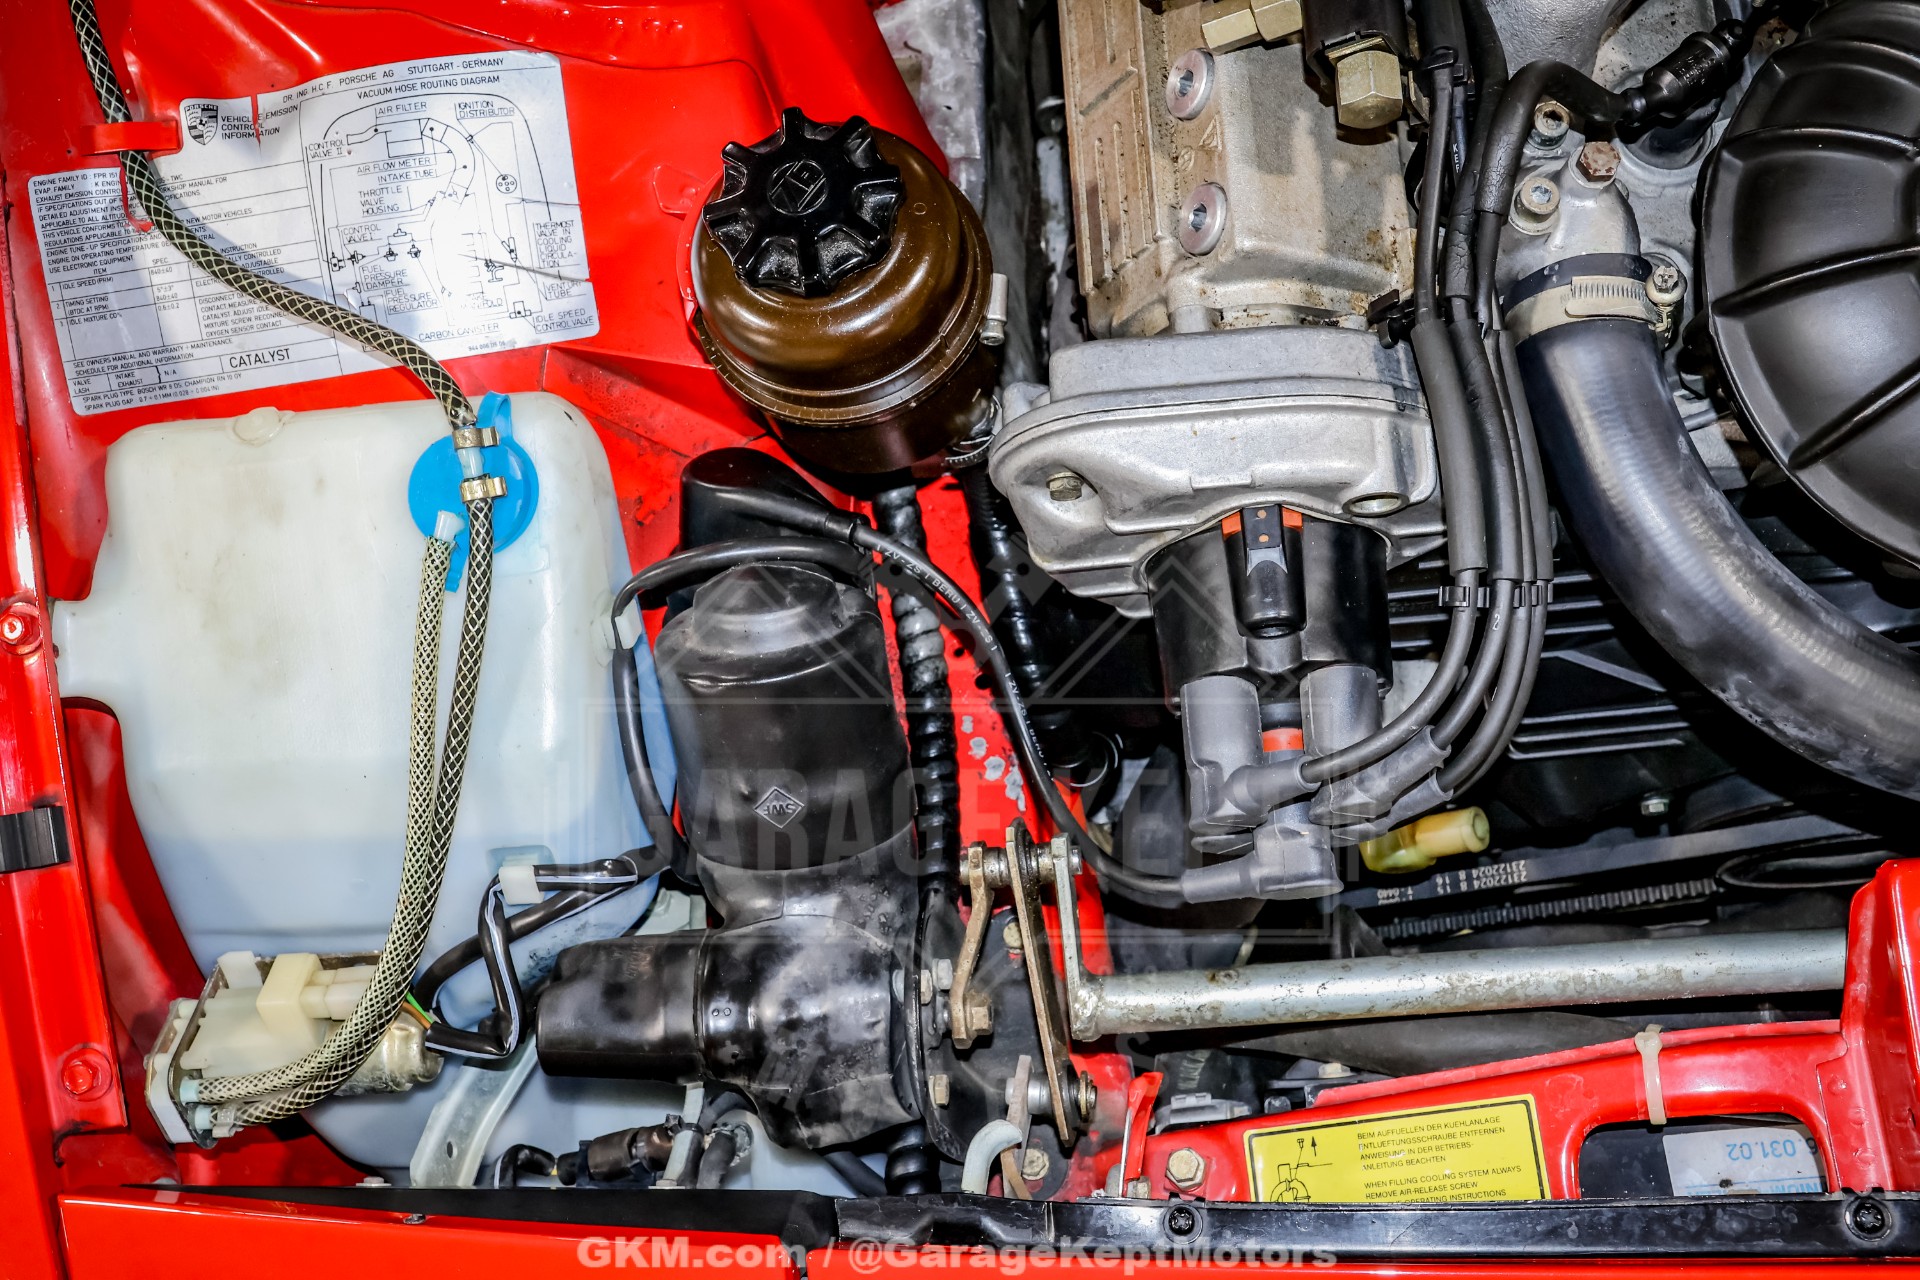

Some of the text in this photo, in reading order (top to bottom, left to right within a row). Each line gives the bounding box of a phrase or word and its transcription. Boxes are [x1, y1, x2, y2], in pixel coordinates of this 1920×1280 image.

[340, 73, 377, 86] PORSCHE
[408, 62, 454, 75] STUTTGART
[462, 58, 504, 69] GERMANY
[357, 76, 500, 100] VACUUM HOSE ROUTING DIAGRAM
[378, 102, 427, 115] AIR FILTER
[458, 100, 494, 110] IGNITION
[266, 104, 298, 120] EMISSION
[459, 107, 515, 118] DISTRIBUTOR
[308, 139, 345, 151] CONTROL
[310, 150, 332, 159] VALVE
[374, 162, 396, 171] FLOW
[398, 157, 431, 168] METER
[378, 169, 434, 182] INTAKE TUBE
[33, 179, 56, 187] ENGINE
[54, 184, 74, 192] FAMILY
[189, 178, 214, 188] MANUAL
[36, 191, 93, 203] EXHAUST EMISSION
[358, 185, 402, 198] THROTTLE
[45, 201, 92, 212] SPECIFICATIONS
[360, 197, 384, 207] VALVE
[39, 207, 108, 221] DETAILED ADJUSTMENT
[203, 213, 222, 222] MOTOR
[224, 208, 252, 218] VEHICLES
[362, 204, 400, 216] HOUSING
[41, 219, 76, 229] APPLICABLE
[57, 228, 80, 237] VEHICLE
[82, 223, 115, 233] CONFORMS
[343, 224, 381, 235] CONTROL
[536, 220, 574, 229] THERMOST
[44, 231, 121, 247] REGULATIONS APPLICABLE
[346, 234, 368, 243] VALVE
[537, 229, 558, 237] VALVE
[46, 248, 68, 257] ENGINE
[100, 236, 148, 249] SPECIFICATIONS
[536, 236, 572, 246] COOLING
[48, 242, 159, 265] ENGINE OPERATING TEMPERATURE
[244, 249, 281, 259] CONTROLLED
[63, 261, 98, 272] ELECTRONIC
[100, 255, 133, 266] EQUIPMENT
[362, 265, 385, 273] FUEL
[364, 269, 408, 281] PRESSURE
[77, 279, 96, 287] SPEED
[366, 279, 403, 289] DAMPER
[385, 287, 406, 296] FUEL
[548, 290, 571, 299] TUBE
[86, 296, 108, 304] SETTING
[198, 293, 235, 304] DISCONNECT
[228, 298, 256, 309] MEASURE
[387, 292, 432, 304] PRESSURE
[234, 307, 254, 316] ADJUST
[389, 300, 438, 312] REGULATOR
[83, 314, 107, 323] MIXTURE
[558, 308, 585, 319] SPEED
[204, 316, 252, 329] MIXTURE SCREW
[205, 320, 282, 337] OXYGEN SENSOR CONTACT
[536, 316, 594, 332] CONTROL VALVE
[419, 323, 499, 340] CARBON CANISTER
[86, 358, 111, 367] OWNERS
[112, 354, 137, 363] MANUAL
[152, 346, 184, 357] WARRANTY
[191, 338, 233, 350] MAINTENANCE
[230, 348, 290, 368] CATALYST
[76, 366, 106, 376] SCHEDULE
[120, 360, 153, 370] ADDITIONAL
[155, 353, 194, 365] INFORMATION
[117, 379, 143, 388] EXHAUST
[83, 394, 102, 403] SPARK
[137, 386, 156, 395] BOSCH
[184, 377, 215, 387] CHAMPION
[85, 402, 104, 411] SPARK
[1492, 614, 1500, 630] 2
[1357, 1116, 1501, 1140] BEIM AUFFUELLEN DER KUEHLANLAGE
[1359, 1126, 1506, 1151] ENTLUEFTUNGSSCHRAUBE ENTFERNEN
[1360, 1149, 1406, 1161] ANWEISUNG
[1417, 1146, 1433, 1154] DER
[1362, 1155, 1446, 1172] ANLEITUNG BEACHTEN
[1364, 1165, 1521, 1189] WHEN FILLING COOLING SYSTEM ALWAYS
[1366, 1182, 1478, 1200] REMOVE AIR-RELEASE SCREW
[1451, 1189, 1506, 1202] INSTRUCTIONS
